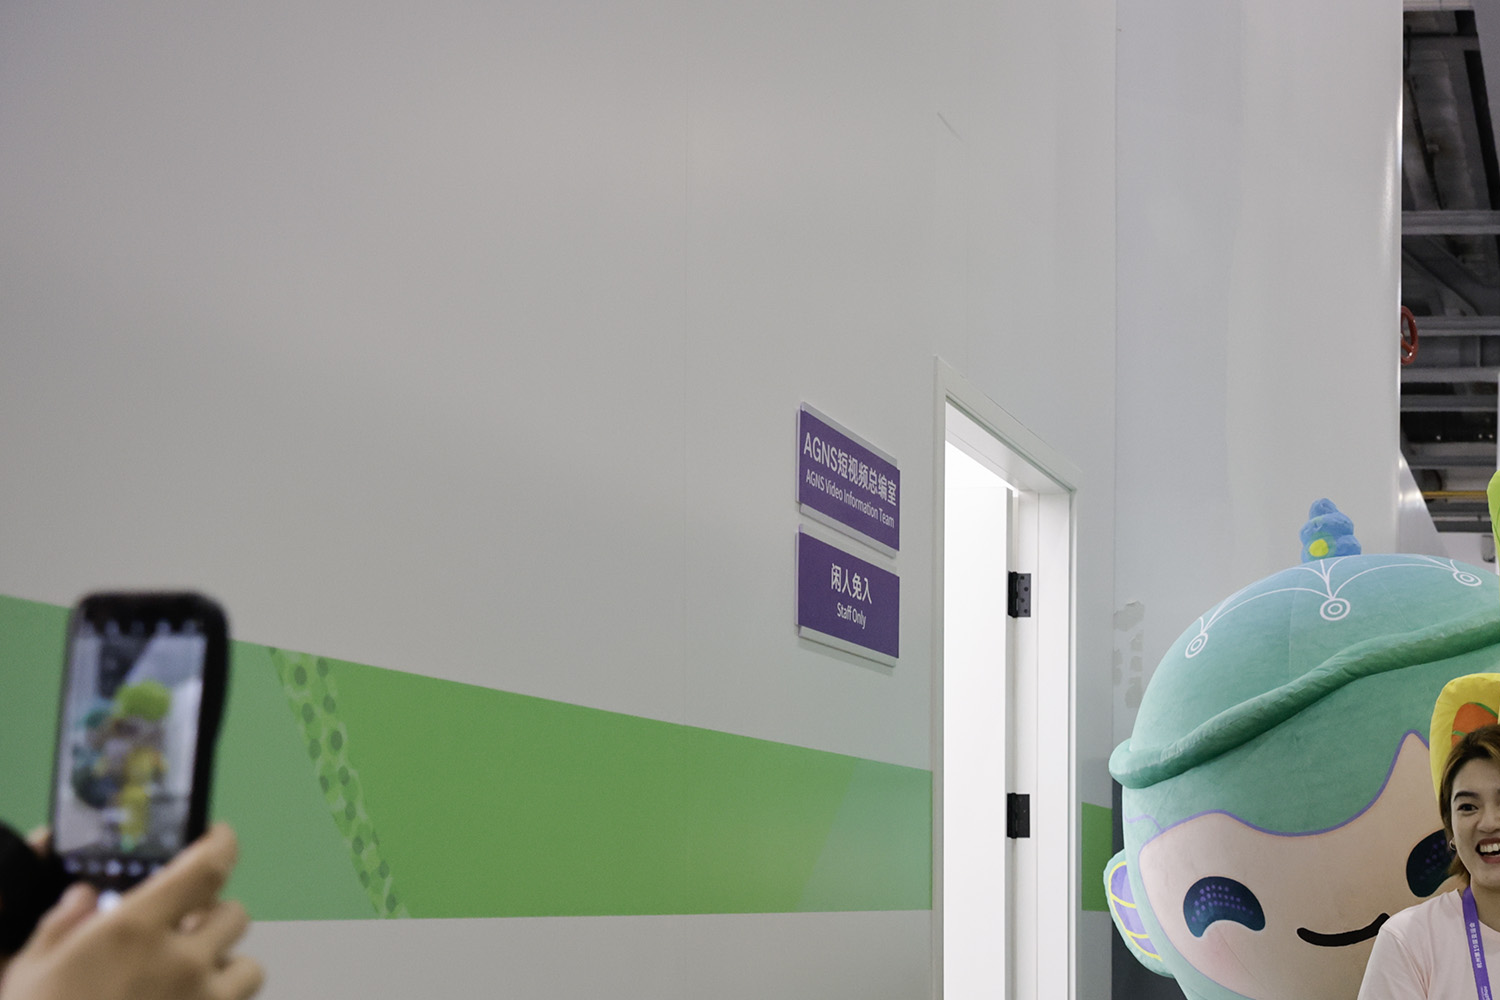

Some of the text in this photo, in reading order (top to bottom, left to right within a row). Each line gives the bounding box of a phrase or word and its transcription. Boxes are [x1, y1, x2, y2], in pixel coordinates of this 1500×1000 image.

[803, 431, 897, 507] AGNS短视频总编室
[805, 469, 895, 528] AGNS Video Information Team
[831, 562, 873, 605] 闲人免入
[836, 602, 867, 630] Staff Only
